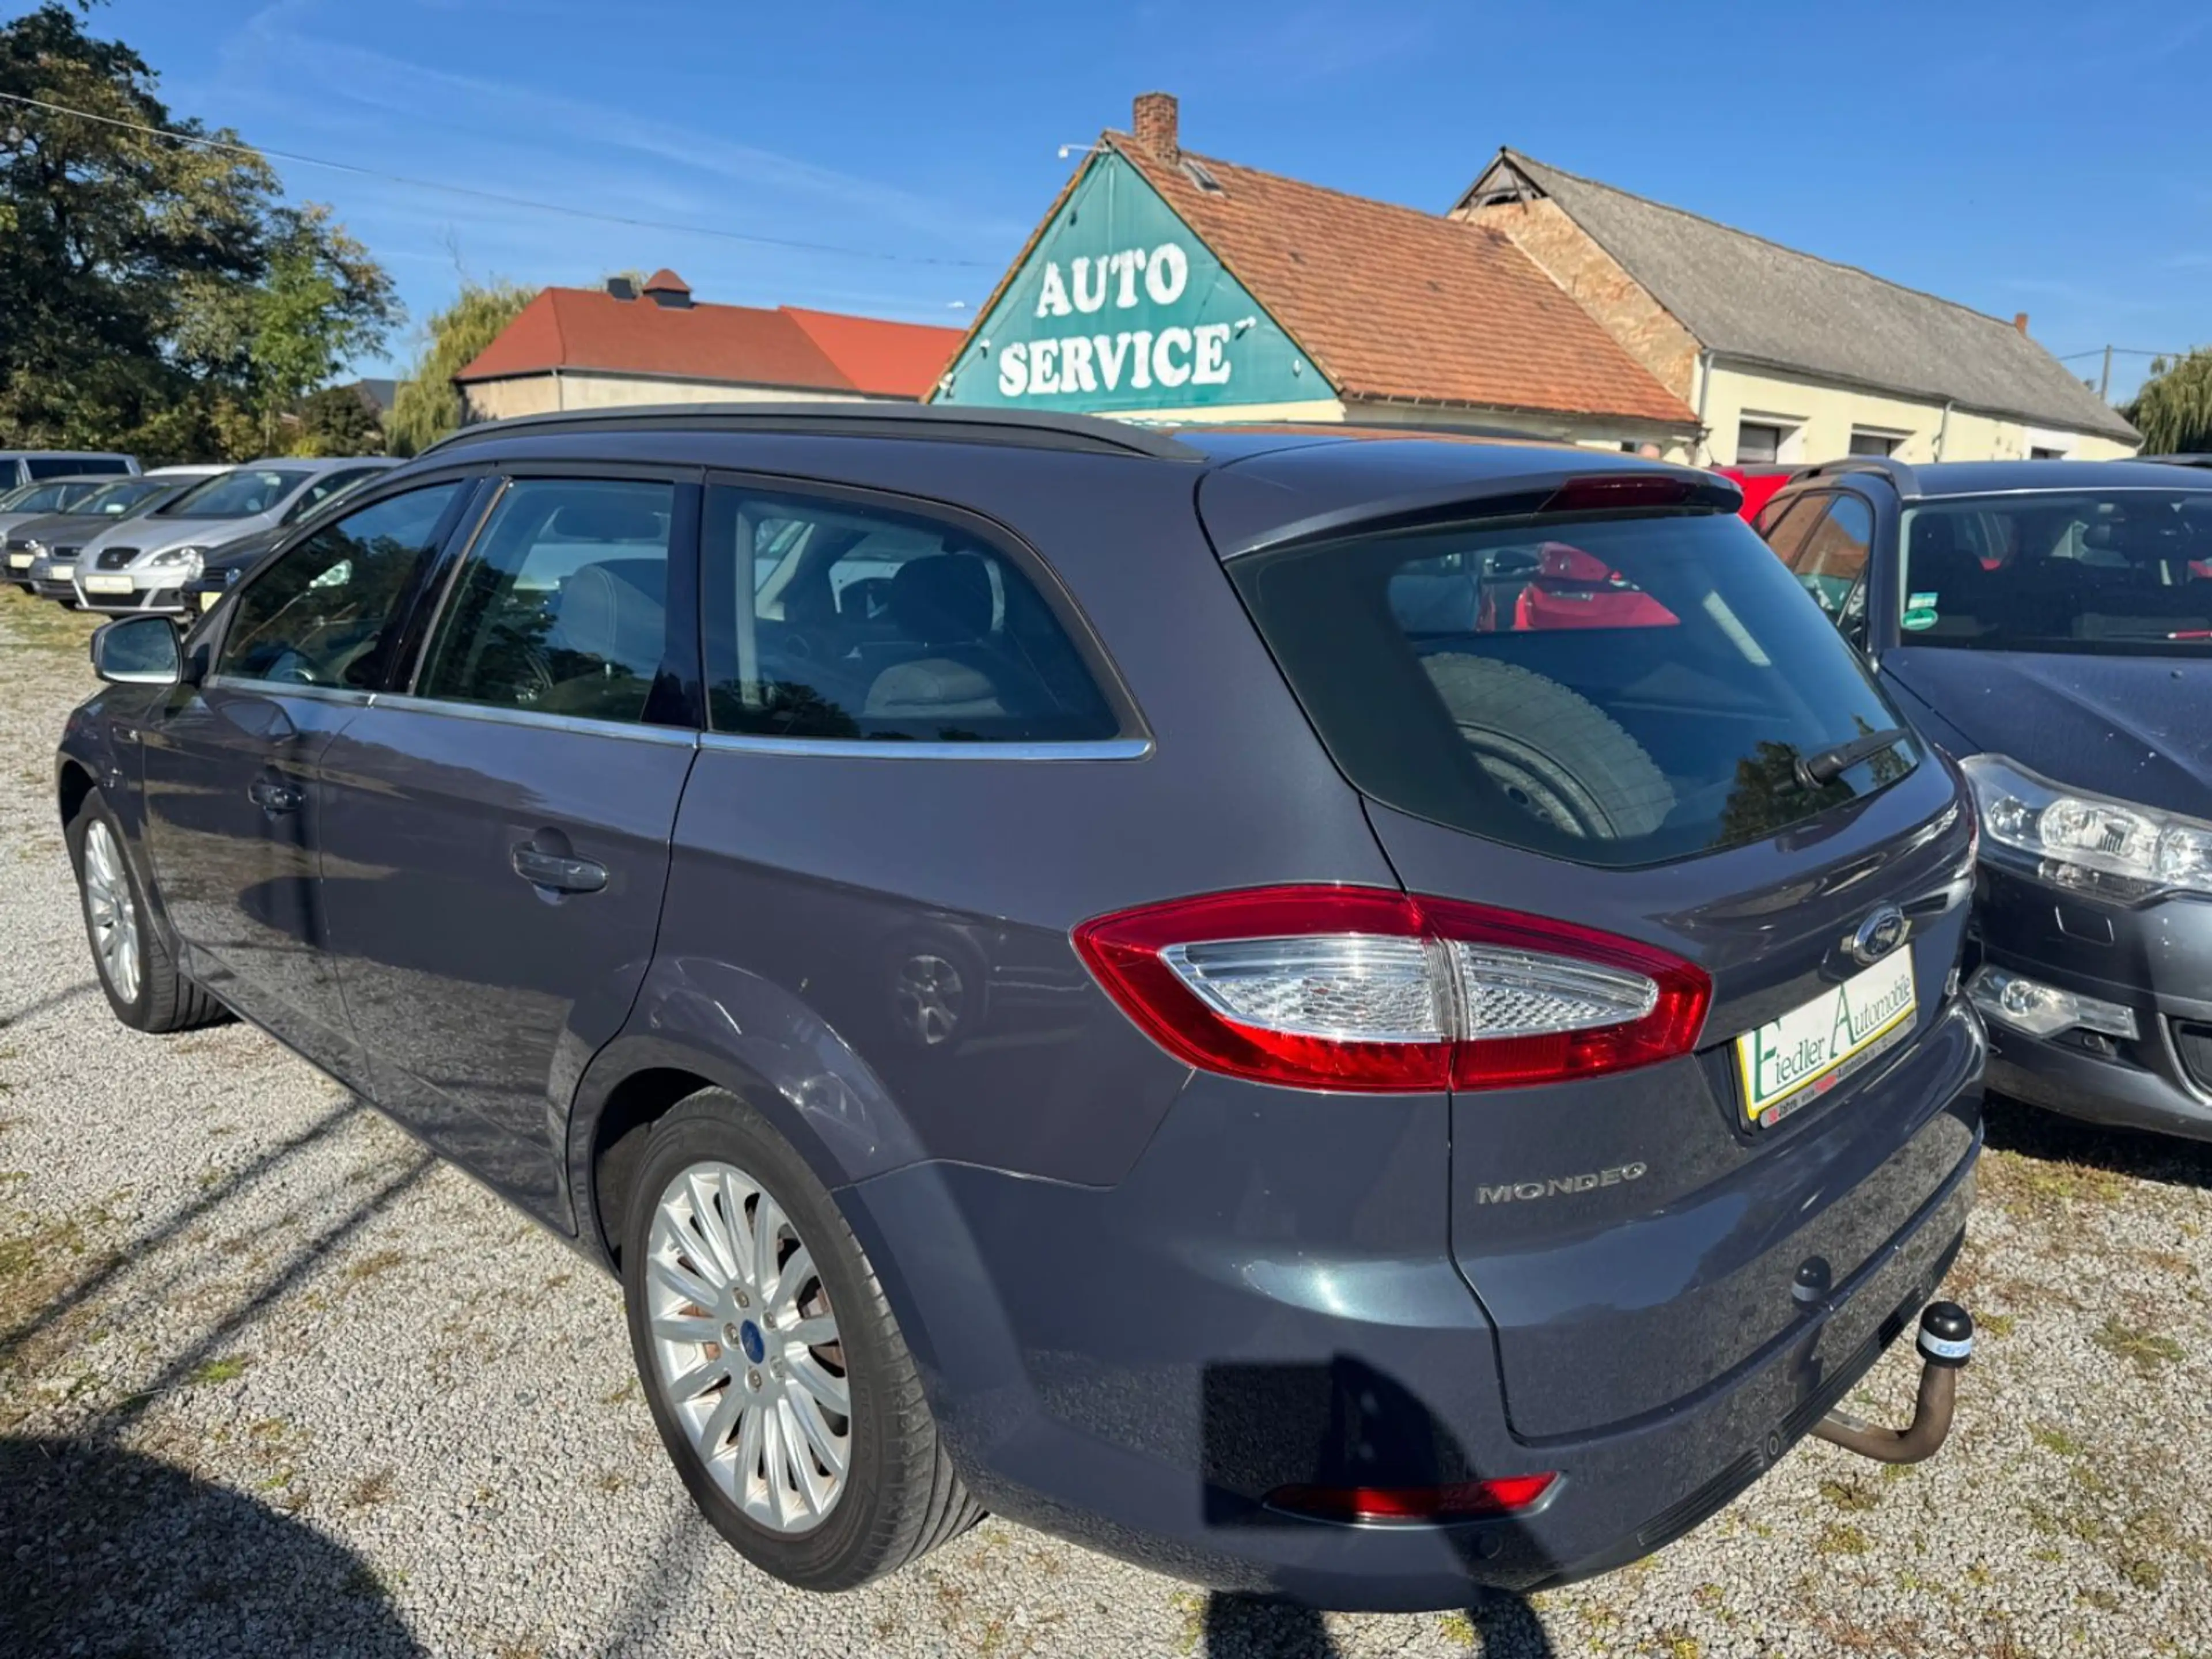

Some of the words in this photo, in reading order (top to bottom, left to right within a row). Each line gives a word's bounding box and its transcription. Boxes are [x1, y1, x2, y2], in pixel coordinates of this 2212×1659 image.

[1035, 243, 1188, 318] AUTO
[998, 323, 1232, 397] SERVICE
[1752, 1017, 1824, 1103] Fiedler
[1476, 1161, 1647, 1205] MONDEO
